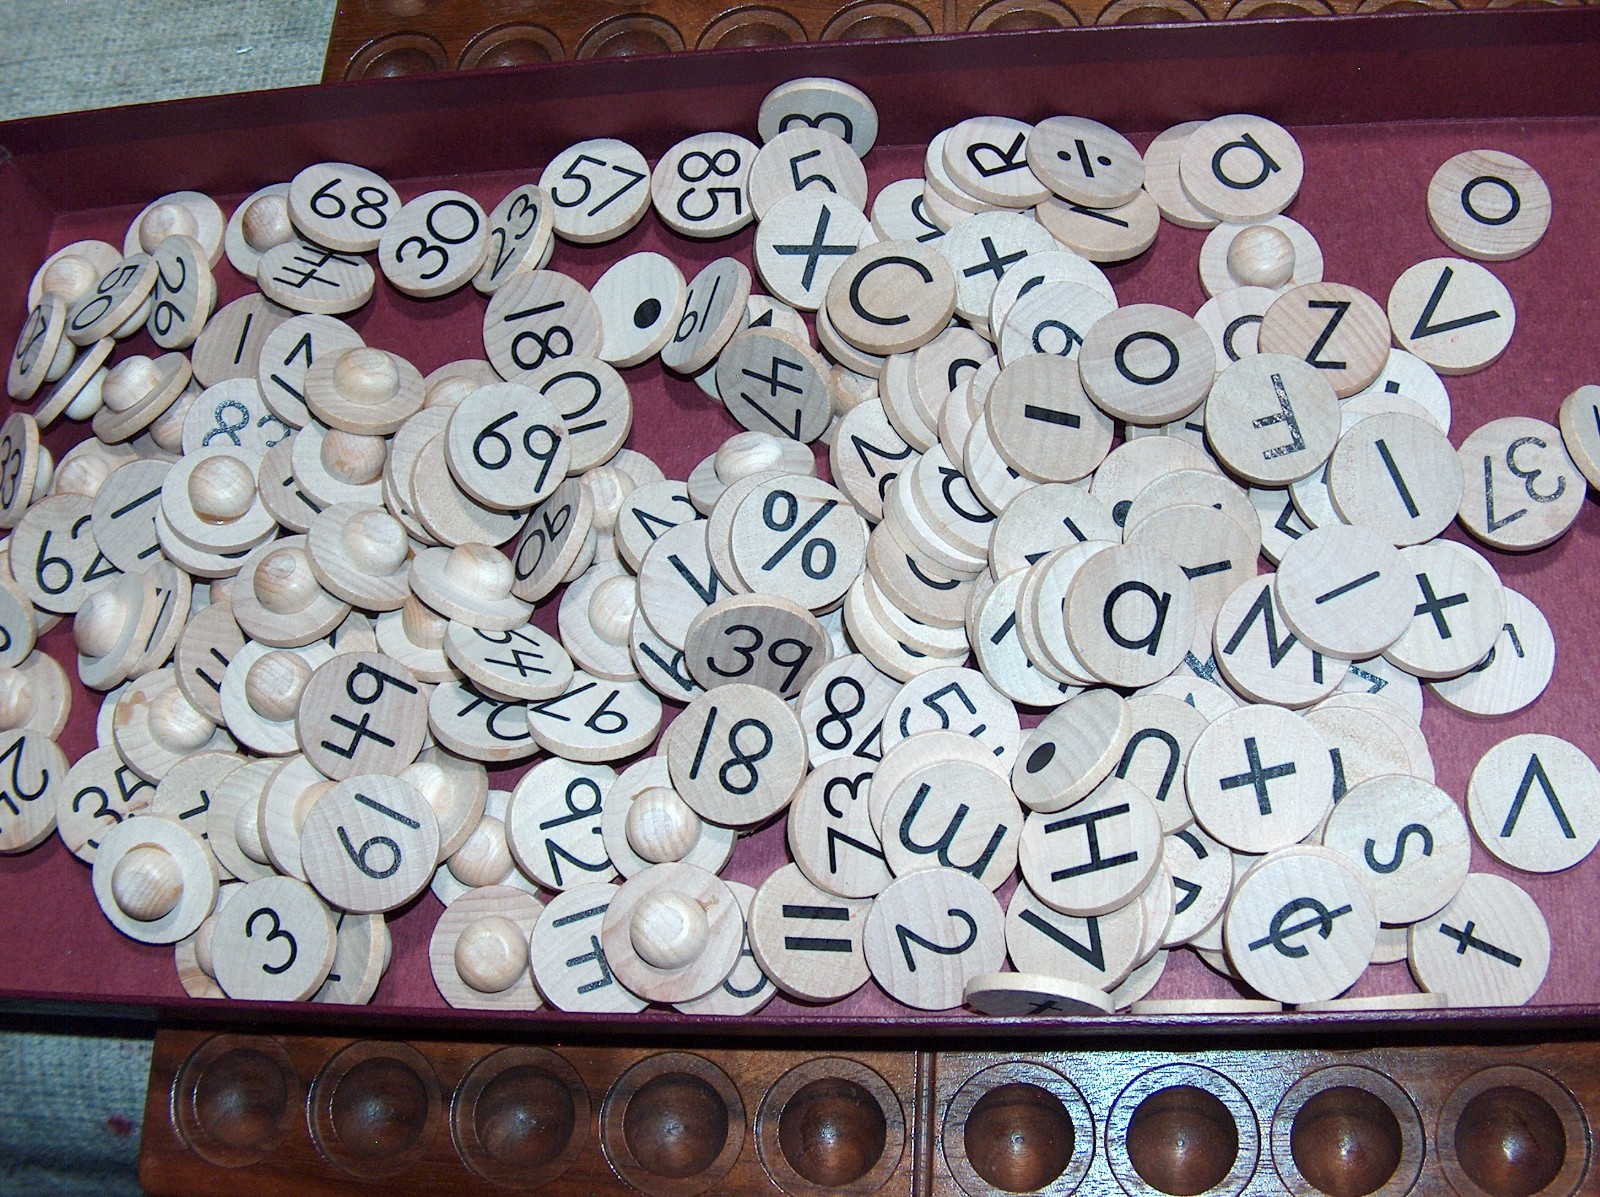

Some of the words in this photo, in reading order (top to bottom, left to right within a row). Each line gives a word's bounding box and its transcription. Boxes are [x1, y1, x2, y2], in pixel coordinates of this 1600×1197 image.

[309, 178, 389, 230] 68
[551, 153, 648, 217] 57
[395, 199, 480, 280] 30
[706, 624, 813, 693] 39
[245, 906, 298, 975] 3
[895, 907, 979, 973] 2
